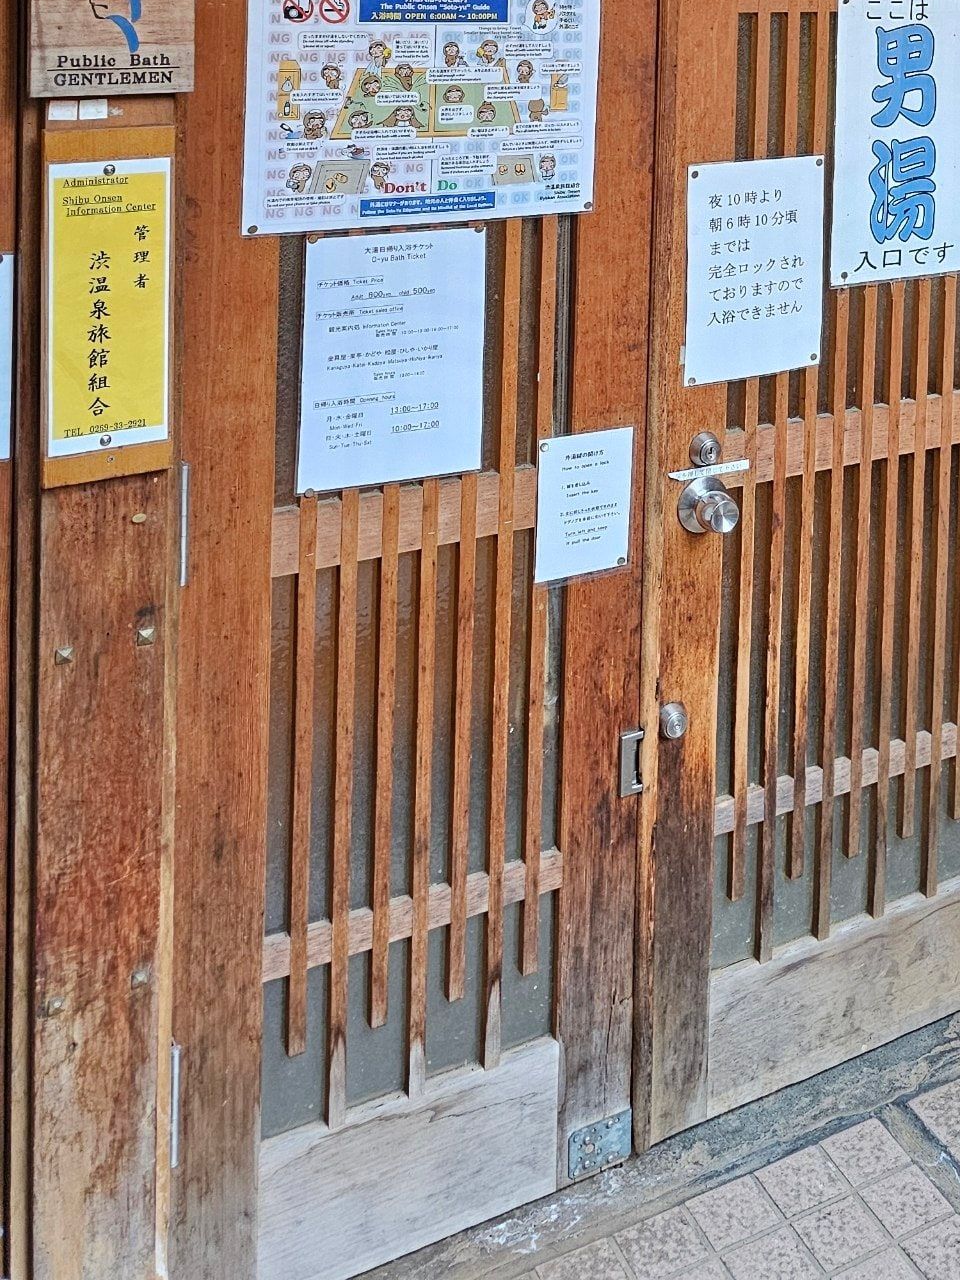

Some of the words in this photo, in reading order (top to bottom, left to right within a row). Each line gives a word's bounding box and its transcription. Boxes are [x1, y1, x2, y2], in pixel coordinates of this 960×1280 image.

[270, 34, 289, 43] NG
[57, 54, 116, 68] Public
[130, 54, 171, 67] Bath
[300, 53, 318, 62] NG
[328, 53, 345, 62] NG
[54, 71, 173, 86] GENTLEMEN
[868, 24, 937, 244] 男湯
[267, 170, 286, 179] NG
[406, 164, 424, 172] NG
[62, 176, 128, 188] Administrator
[437, 181, 457, 190] Do
[62, 196, 89, 205] Shibu
[94, 194, 122, 202] Onsen
[708, 189, 782, 209] 夜10時より
[66, 205, 122, 216] Information
[126, 203, 156, 212] Center
[266, 209, 284, 218] NG
[295, 207, 313, 216] NG
[323, 205, 341, 214] NG
[709, 210, 798, 232] 朝6時10分頃
[710, 239, 750, 256] までは
[134, 224, 150, 289] 管理者
[854, 242, 954, 272] 入口です
[708, 255, 804, 280] 完全ロックされ
[709, 277, 803, 302] ておりますので
[707, 300, 803, 326] 入浴できません
[87, 251, 111, 416] 渋温泉旅館組合
[64, 428, 83, 438] TEL
